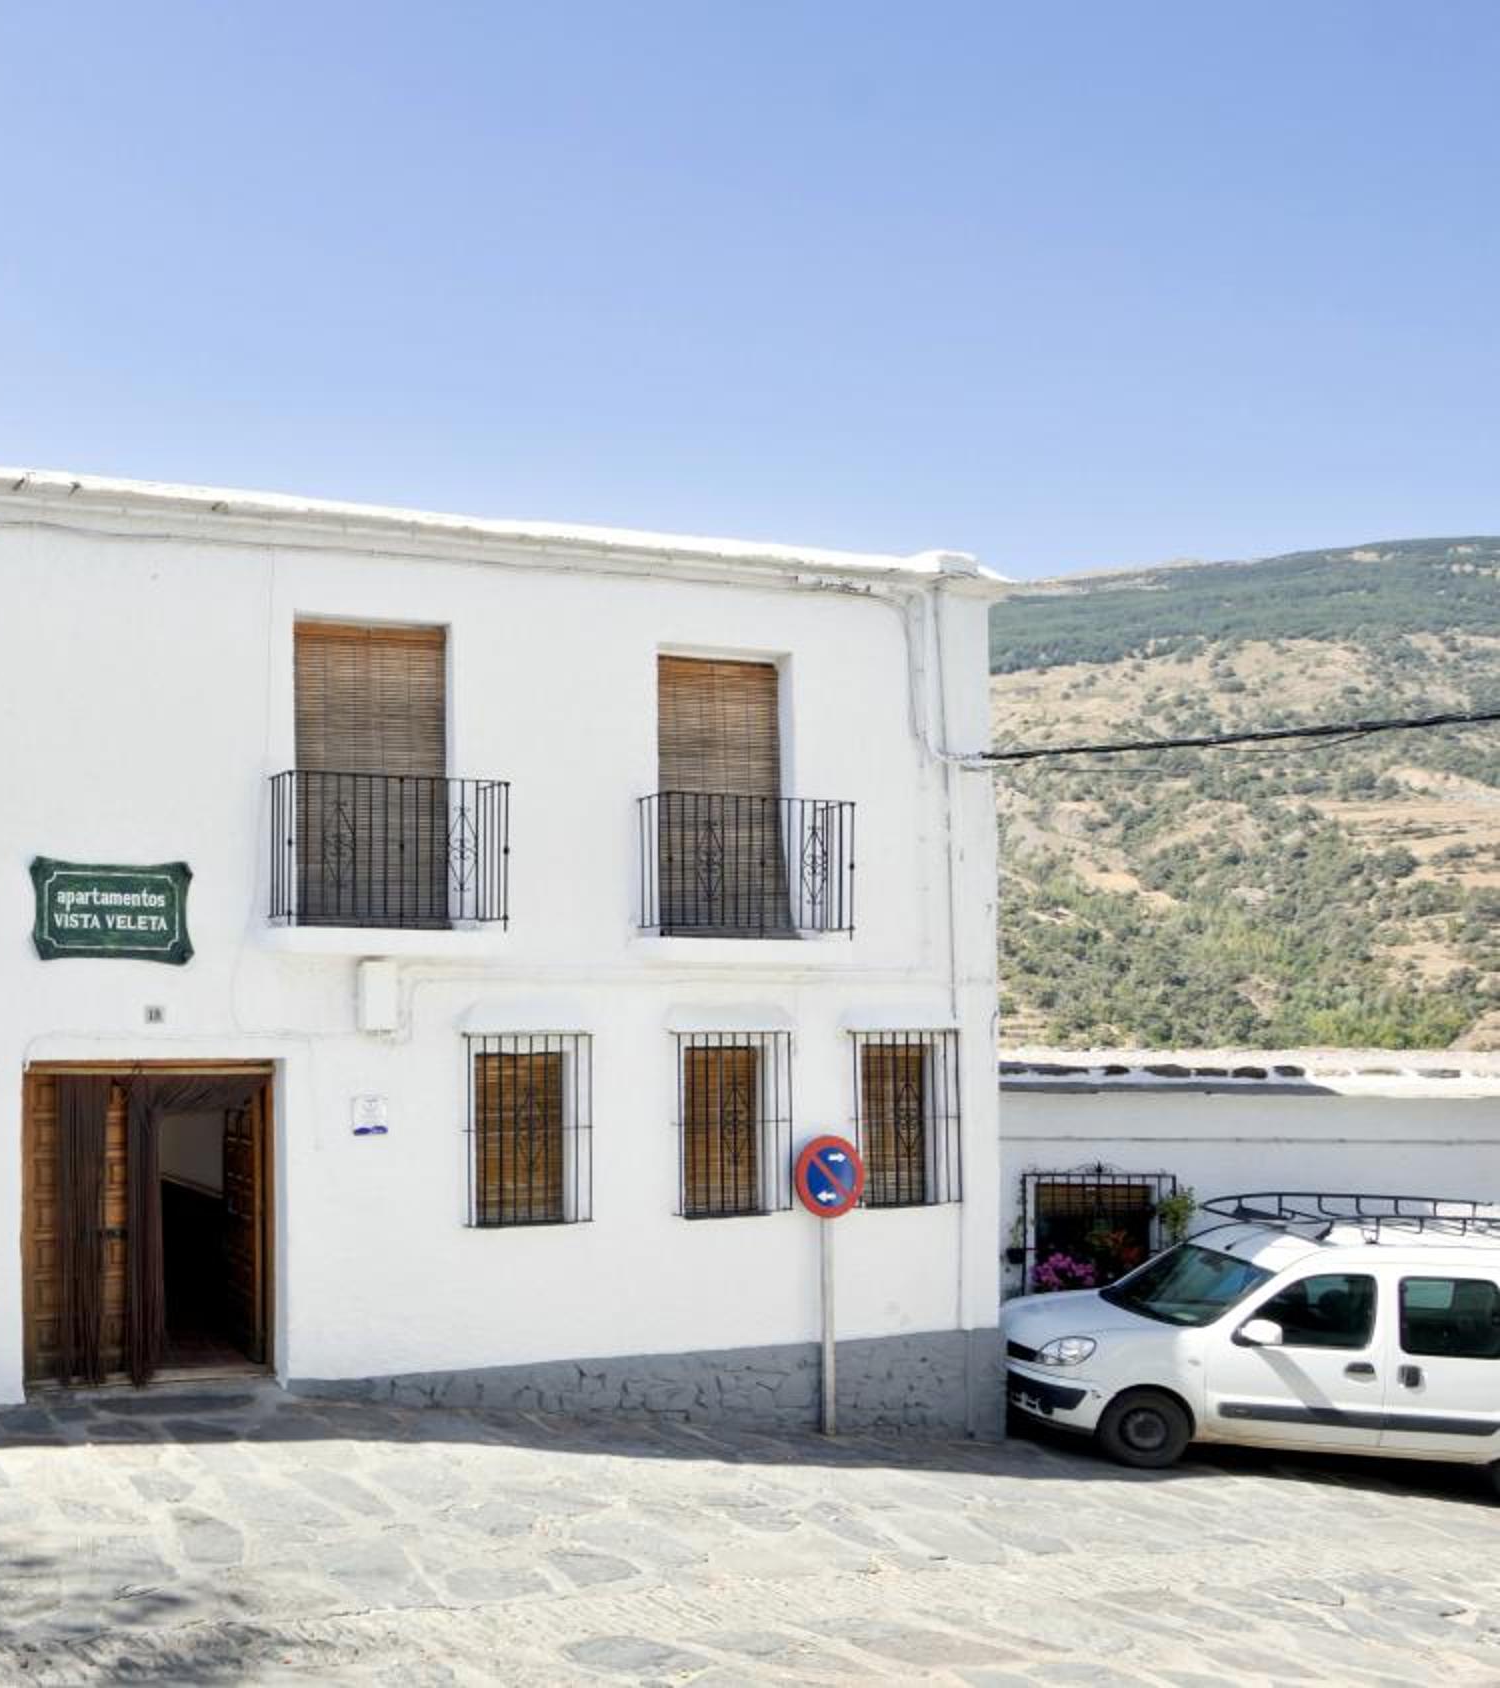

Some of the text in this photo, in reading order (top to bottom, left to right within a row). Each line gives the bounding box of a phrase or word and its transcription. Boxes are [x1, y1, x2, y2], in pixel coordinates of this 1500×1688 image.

[57, 887, 165, 911] apartamentos
[53, 913, 168, 931] VISTA VELETA
